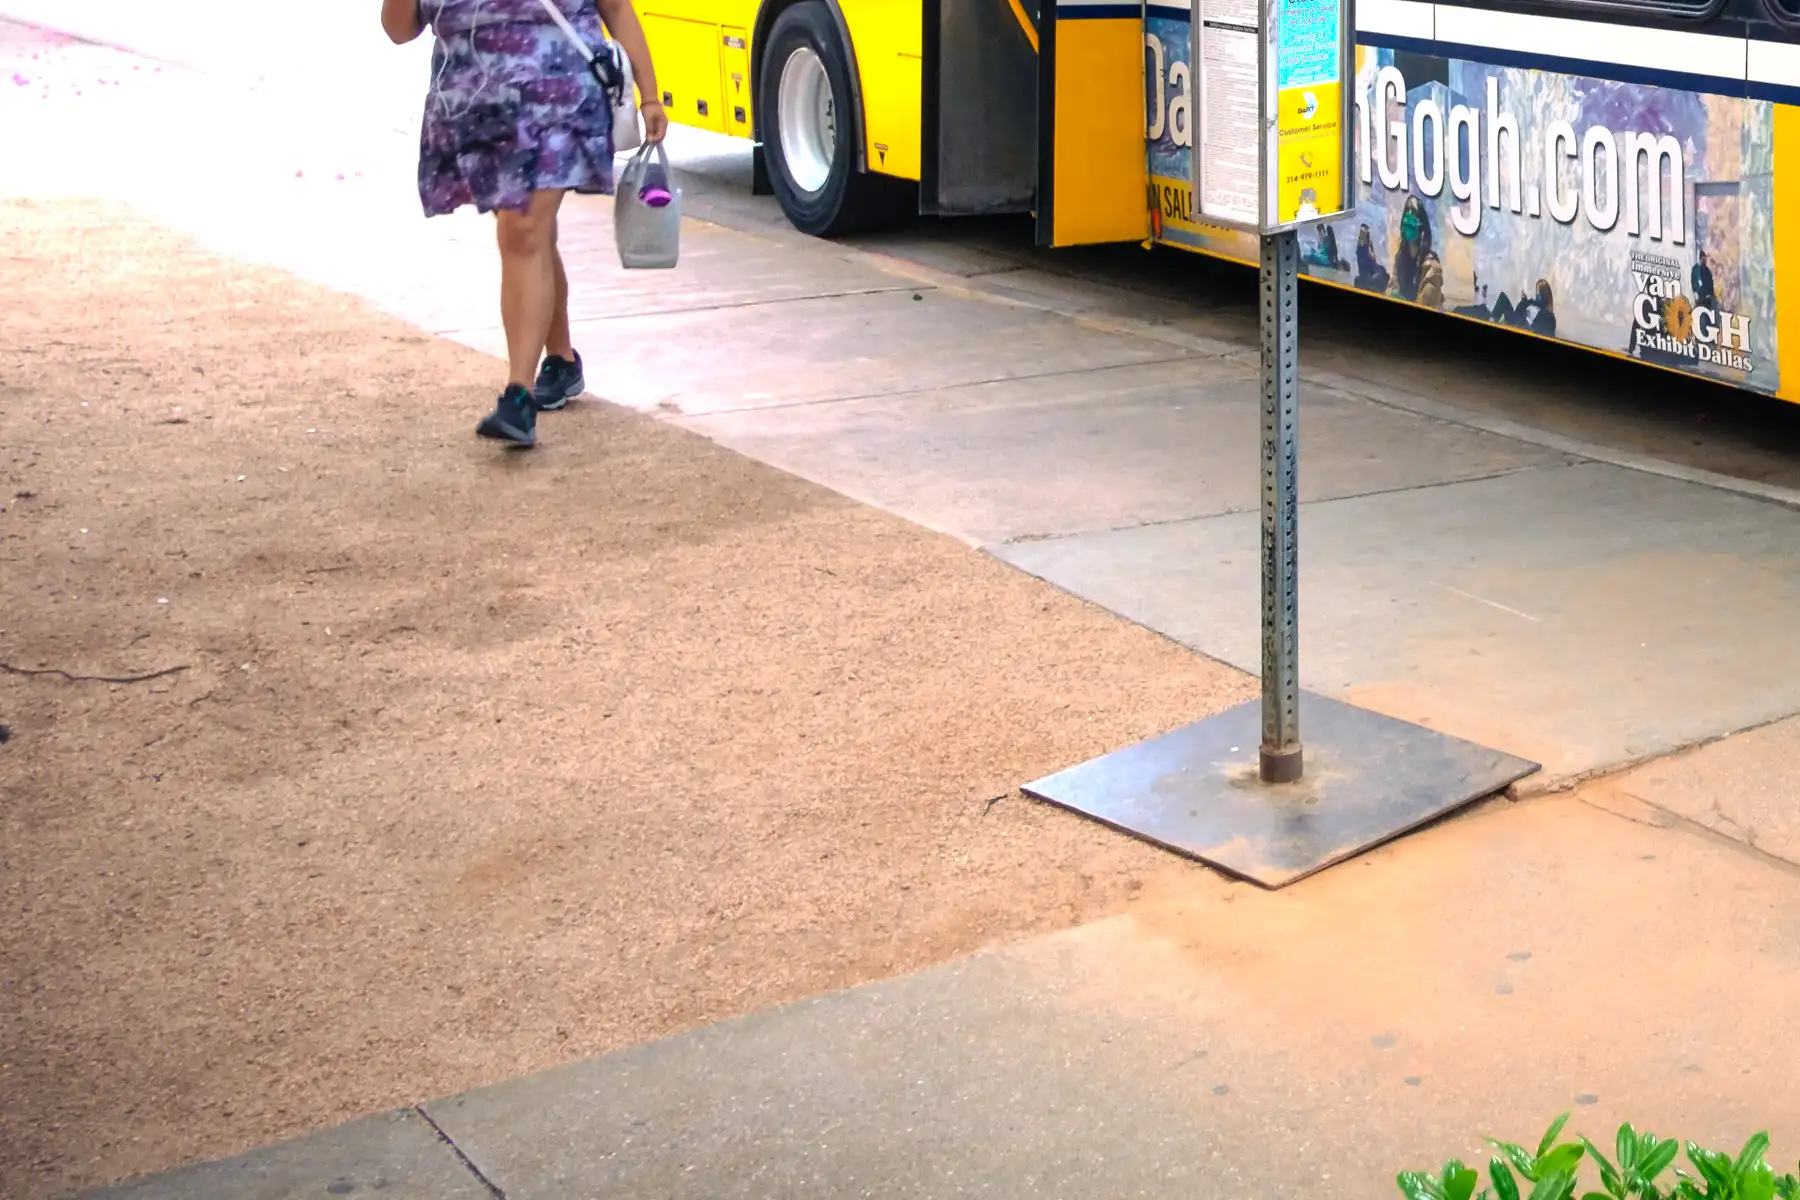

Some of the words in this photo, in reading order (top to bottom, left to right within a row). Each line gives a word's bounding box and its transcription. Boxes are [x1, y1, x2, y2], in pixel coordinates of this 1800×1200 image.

[1279, 124, 1311, 137] Customer
[1312, 121, 1336, 132] Service
[1632, 261, 1681, 280] Immersive
[1636, 328, 1696, 358] Exhibit
[1697, 343, 1753, 372] Dallas
